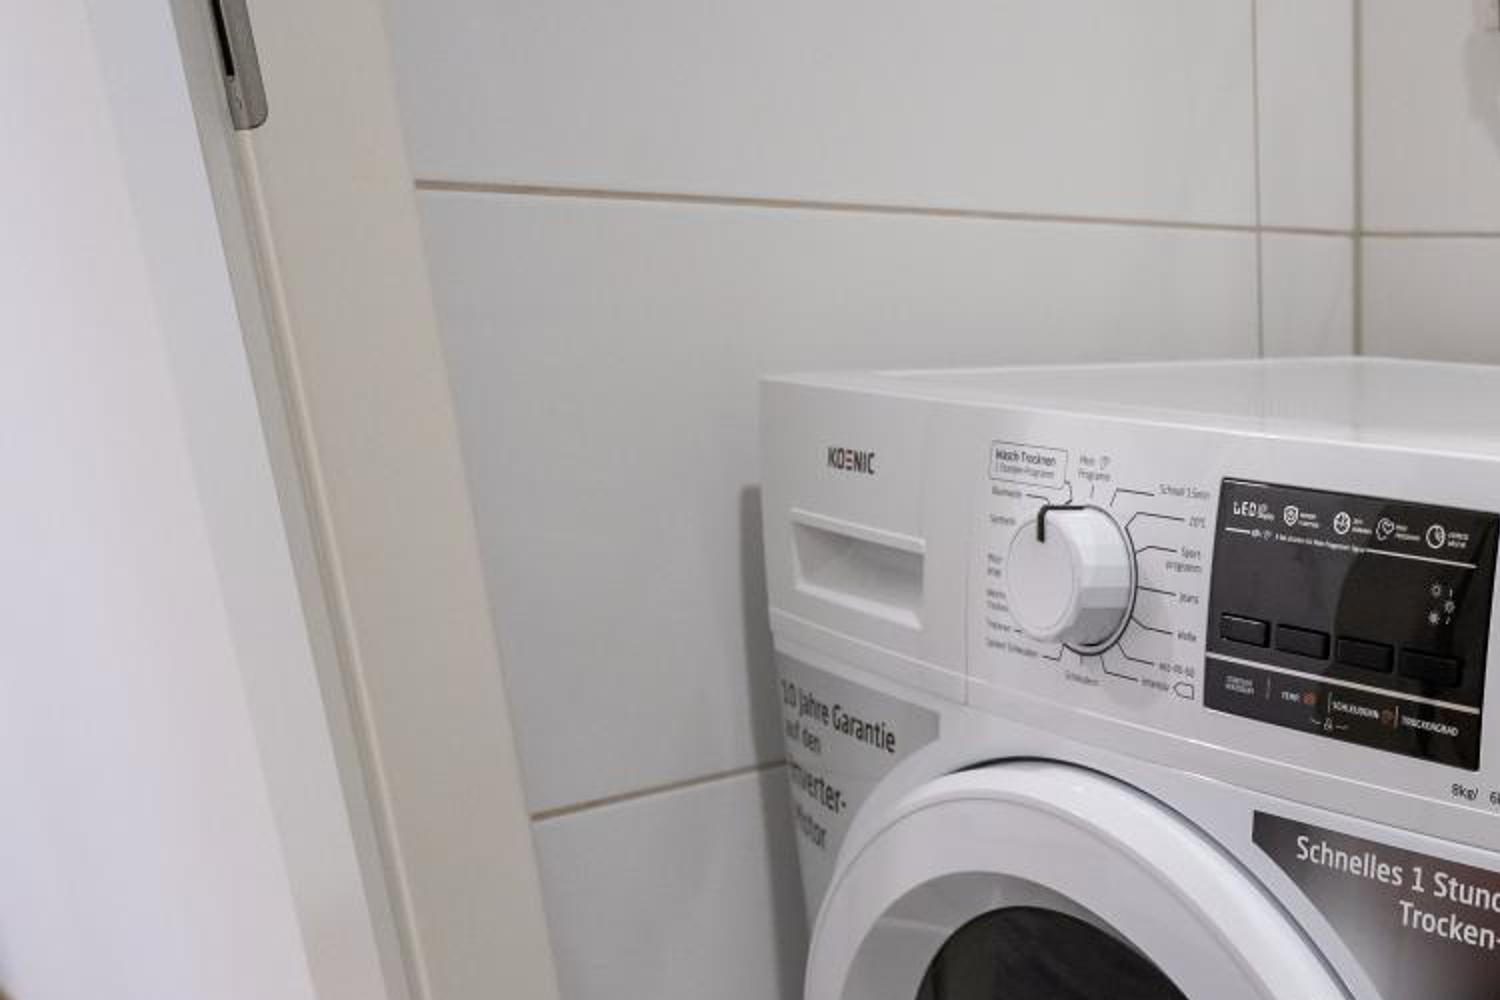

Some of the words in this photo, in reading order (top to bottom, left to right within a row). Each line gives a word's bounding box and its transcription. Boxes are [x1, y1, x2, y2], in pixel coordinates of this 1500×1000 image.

[831, 703, 896, 753] Garantie
[1295, 835, 1403, 887] Schnelles
[1411, 866, 1425, 893] 1
